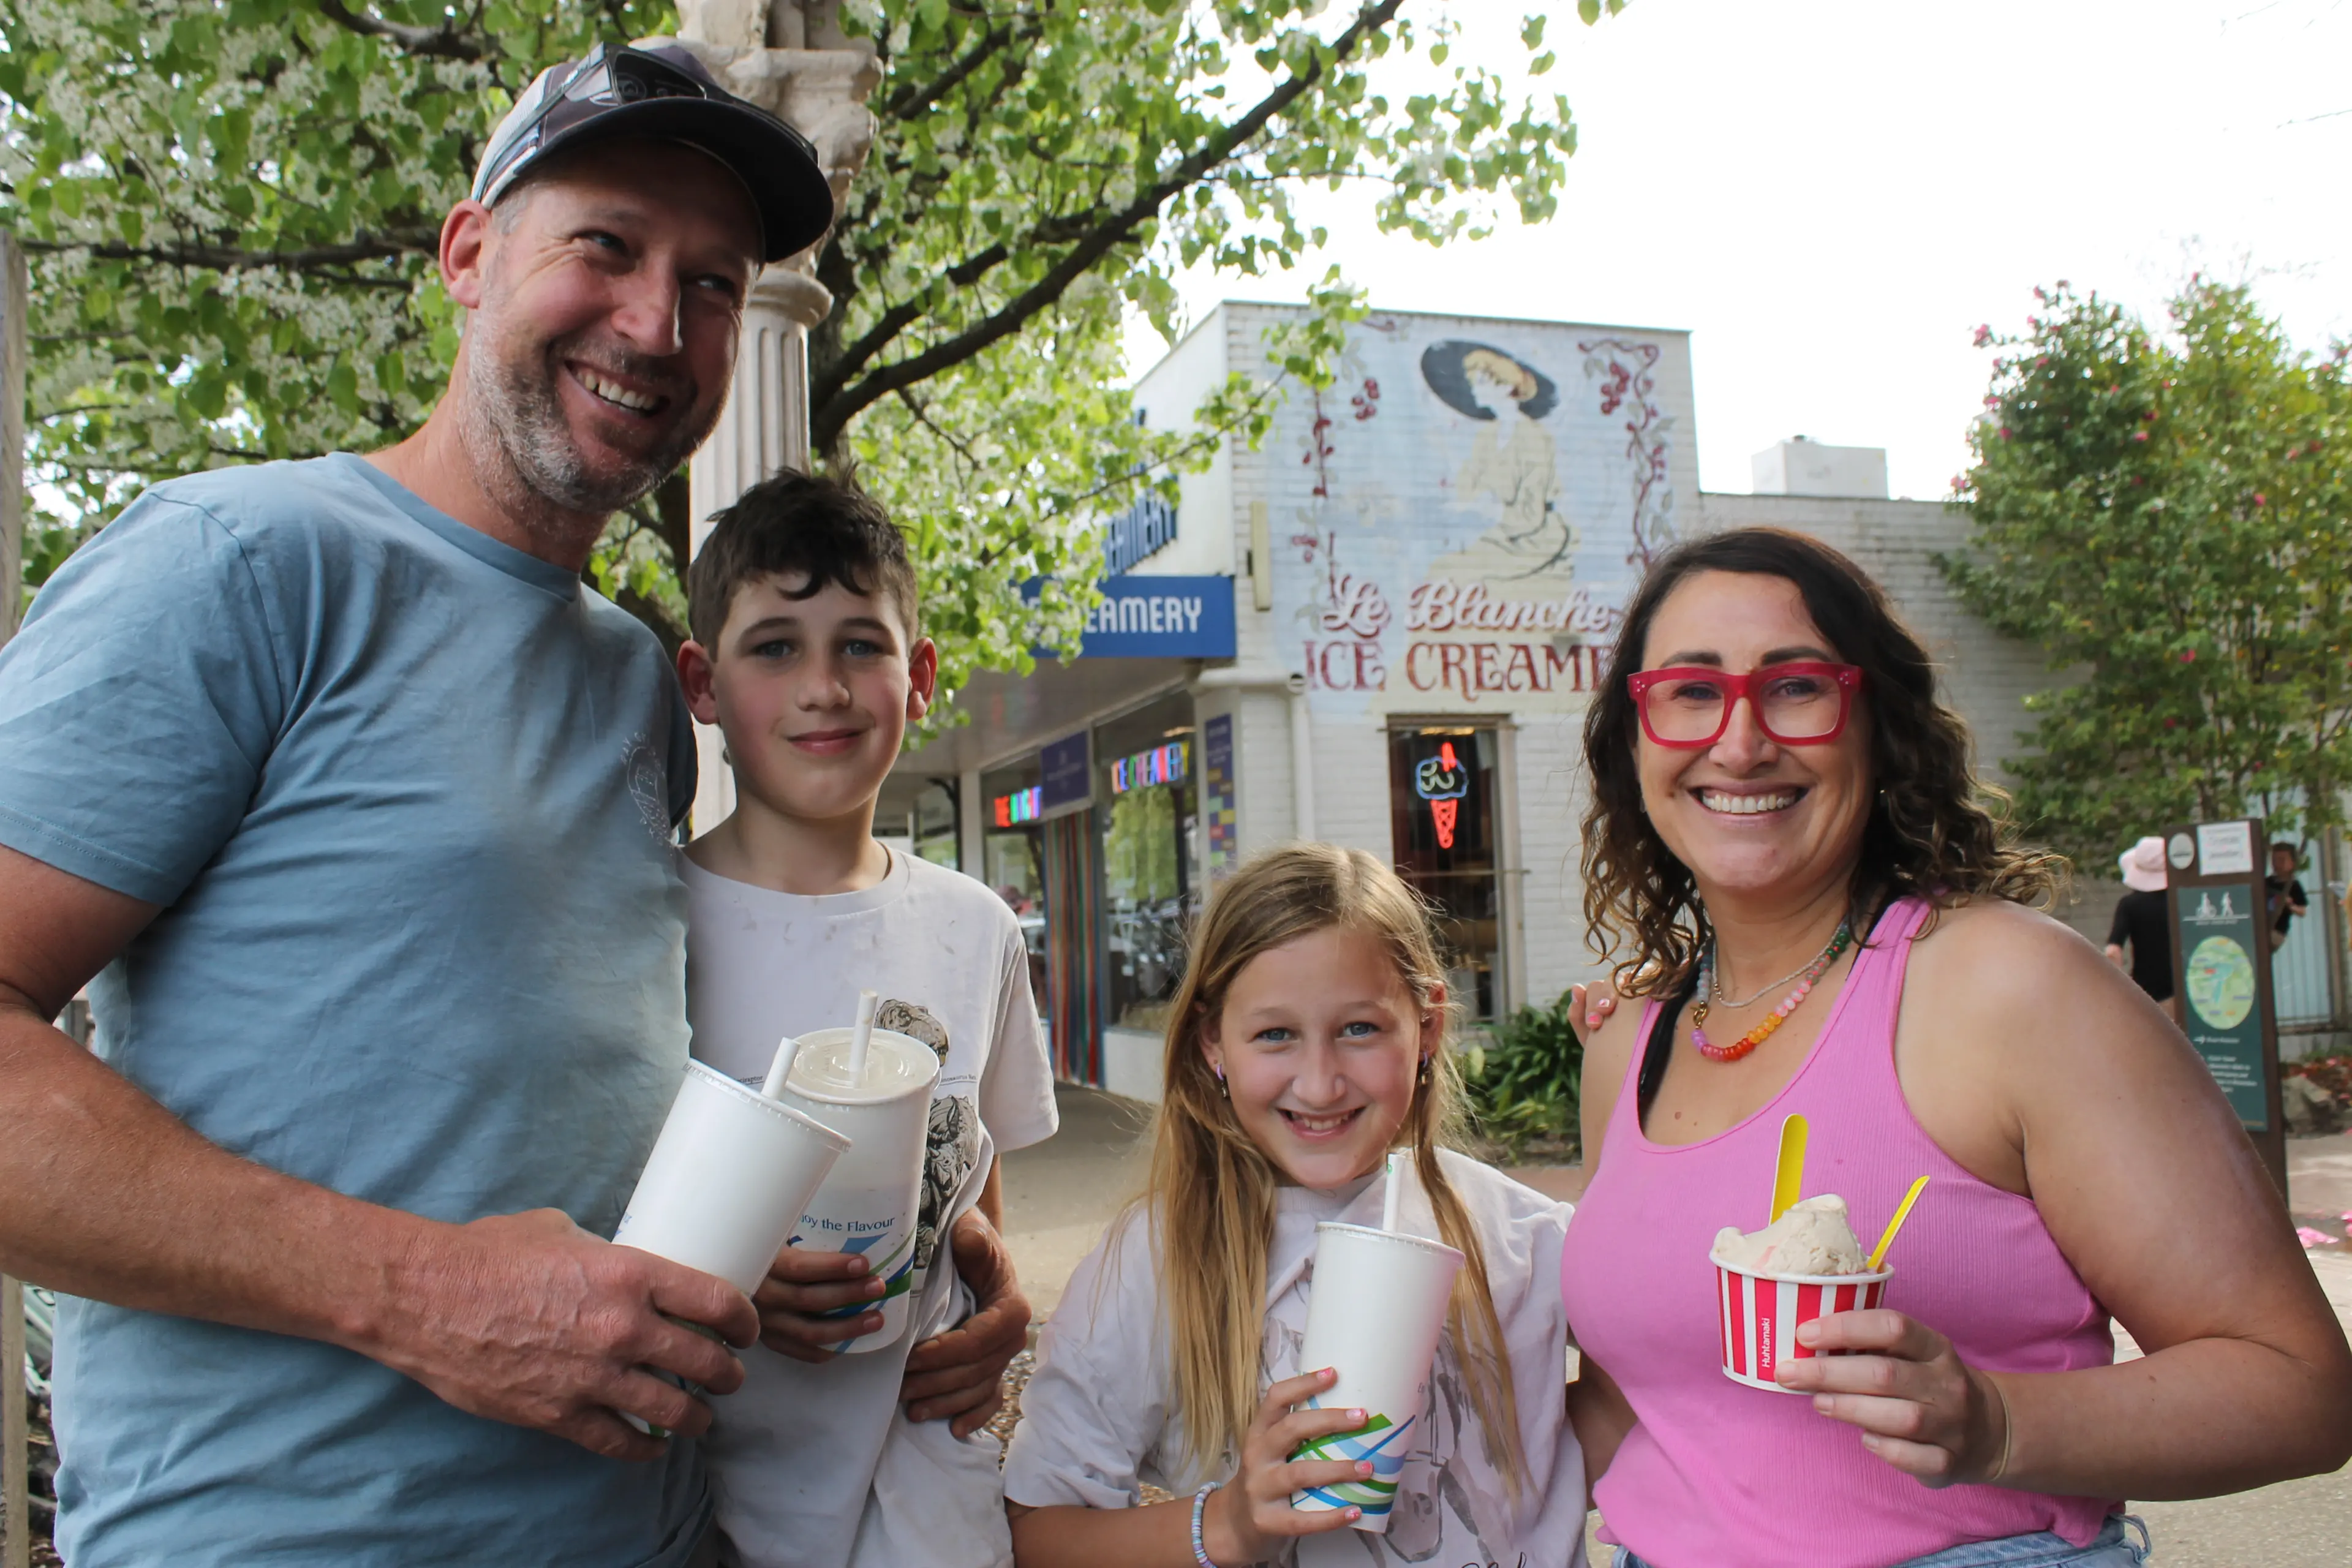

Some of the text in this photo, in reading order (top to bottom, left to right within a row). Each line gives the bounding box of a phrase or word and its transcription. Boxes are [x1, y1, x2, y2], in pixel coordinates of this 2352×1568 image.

[1083, 597, 1202, 633] EAMERY
[1322, 575, 1613, 638] Le Blanche
[1303, 641, 1386, 692] ICE
[822, 1218, 842, 1231] the
[848, 1217, 895, 1232] Flavour
[1762, 1317, 1770, 1368] Huhtamaki
